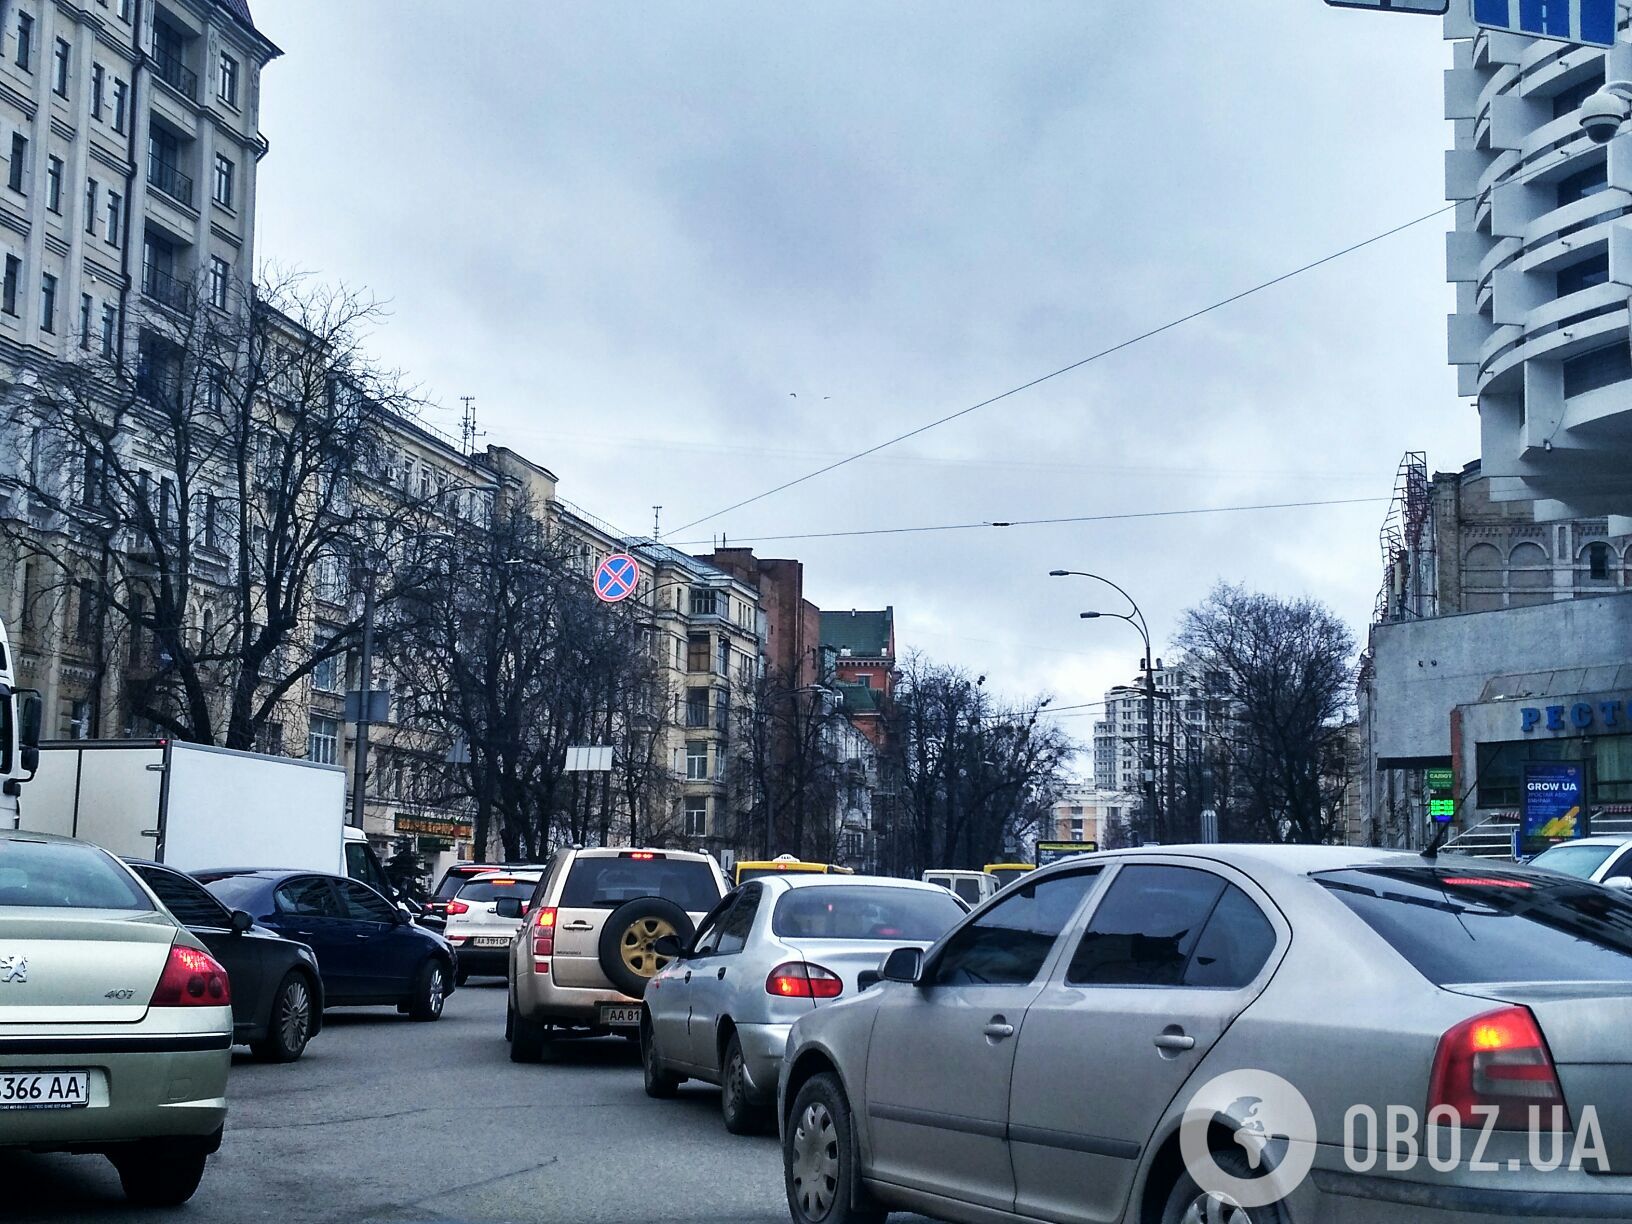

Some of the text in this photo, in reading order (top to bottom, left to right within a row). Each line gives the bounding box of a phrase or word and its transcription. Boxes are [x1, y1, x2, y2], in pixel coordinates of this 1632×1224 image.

[1527, 783, 1577, 791] GROW UA
[104, 989, 134, 999] 407
[610, 1010, 625, 1021] AA
[0, 1077, 80, 1099] 366 AA
